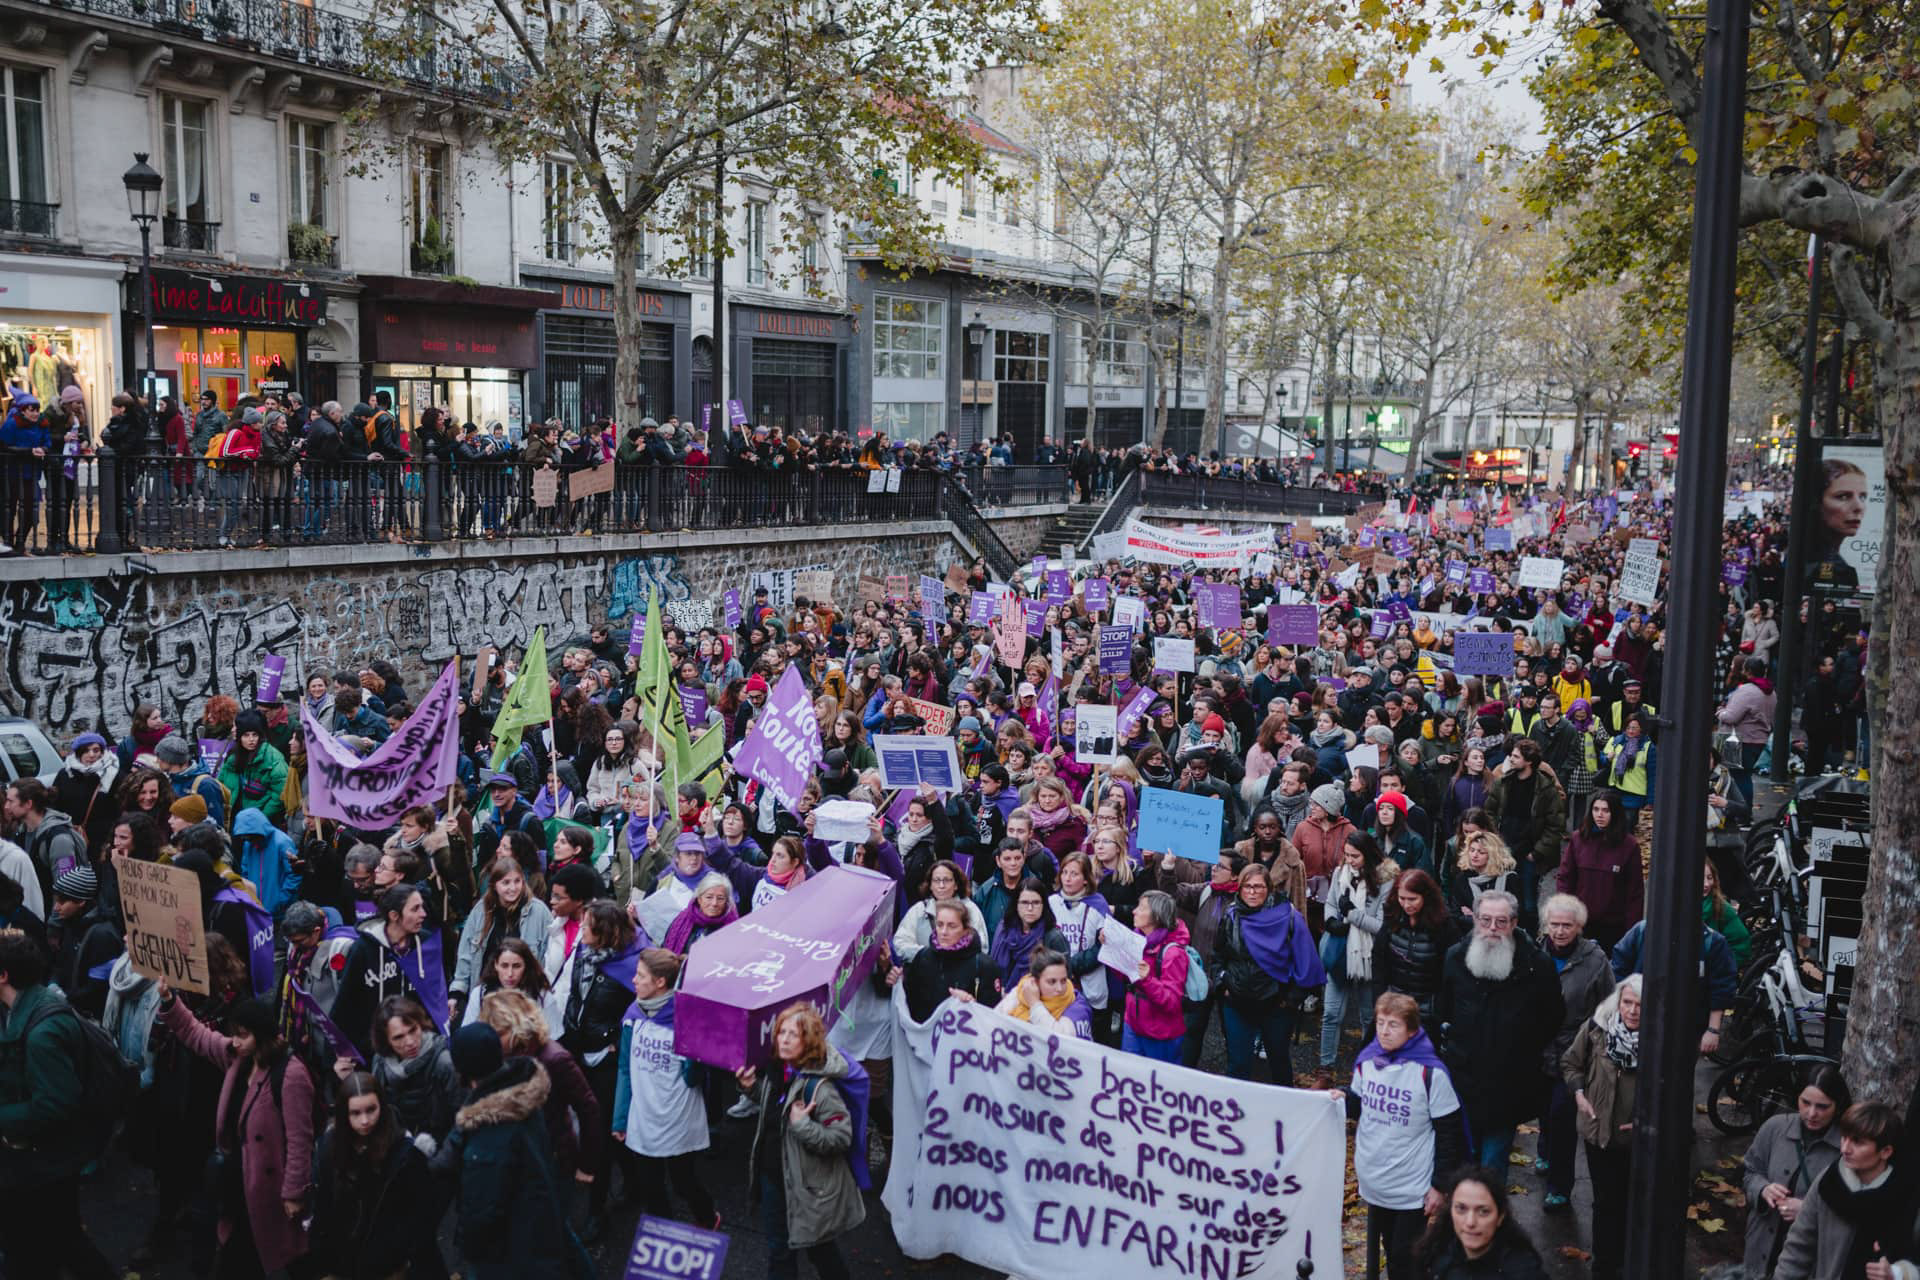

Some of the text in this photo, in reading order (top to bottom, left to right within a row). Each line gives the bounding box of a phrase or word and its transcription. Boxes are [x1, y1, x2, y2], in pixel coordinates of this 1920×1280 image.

[758, 311, 832, 337] LOLLIPOPS
[1102, 631, 1129, 641] STOP!
[146, 864, 171, 885] GARDE
[123, 901, 141, 926] LA
[140, 886, 158, 905] MON
[159, 887, 179, 909] SEIN
[131, 928, 203, 985] GRENADE
[991, 1028, 1034, 1057] pas
[1047, 1035, 1083, 1079] les
[1101, 1055, 1245, 1122] bretonnes
[1367, 1080, 1412, 1102] nous
[949, 1048, 1009, 1085] pour
[1017, 1064, 1074, 1100] des
[1090, 1092, 1246, 1156] CREPES
[1362, 1094, 1411, 1117] outes
[963, 1092, 1066, 1144] mesure
[1080, 1119, 1116, 1158] de
[1137, 1143, 1303, 1197] promesses
[927, 1140, 1288, 1228] assos marchent sur des
[932, 1182, 1006, 1223] nous
[633, 1236, 715, 1280] STOP!
